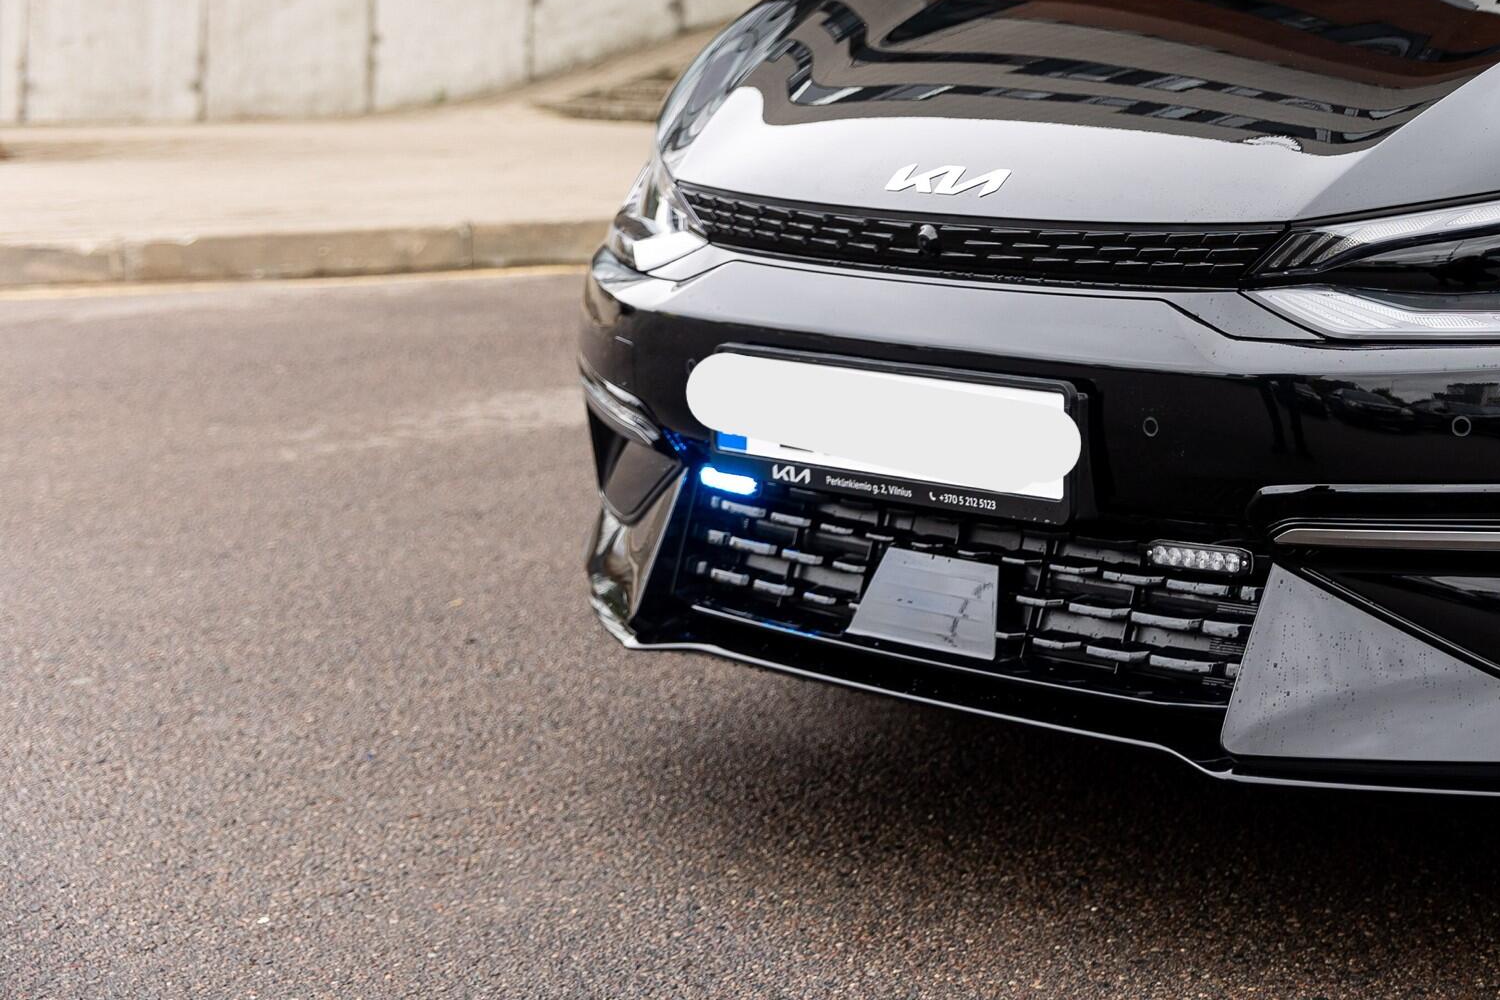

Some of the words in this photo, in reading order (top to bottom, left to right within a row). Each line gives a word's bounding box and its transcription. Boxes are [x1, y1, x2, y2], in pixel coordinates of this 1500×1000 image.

[771, 463, 811, 485] KIA
[888, 484, 913, 498] Vilnius
[939, 493, 958, 504] +370
[959, 495, 965, 506] 5
[965, 496, 978, 508] 212
[978, 498, 997, 510] 5123
